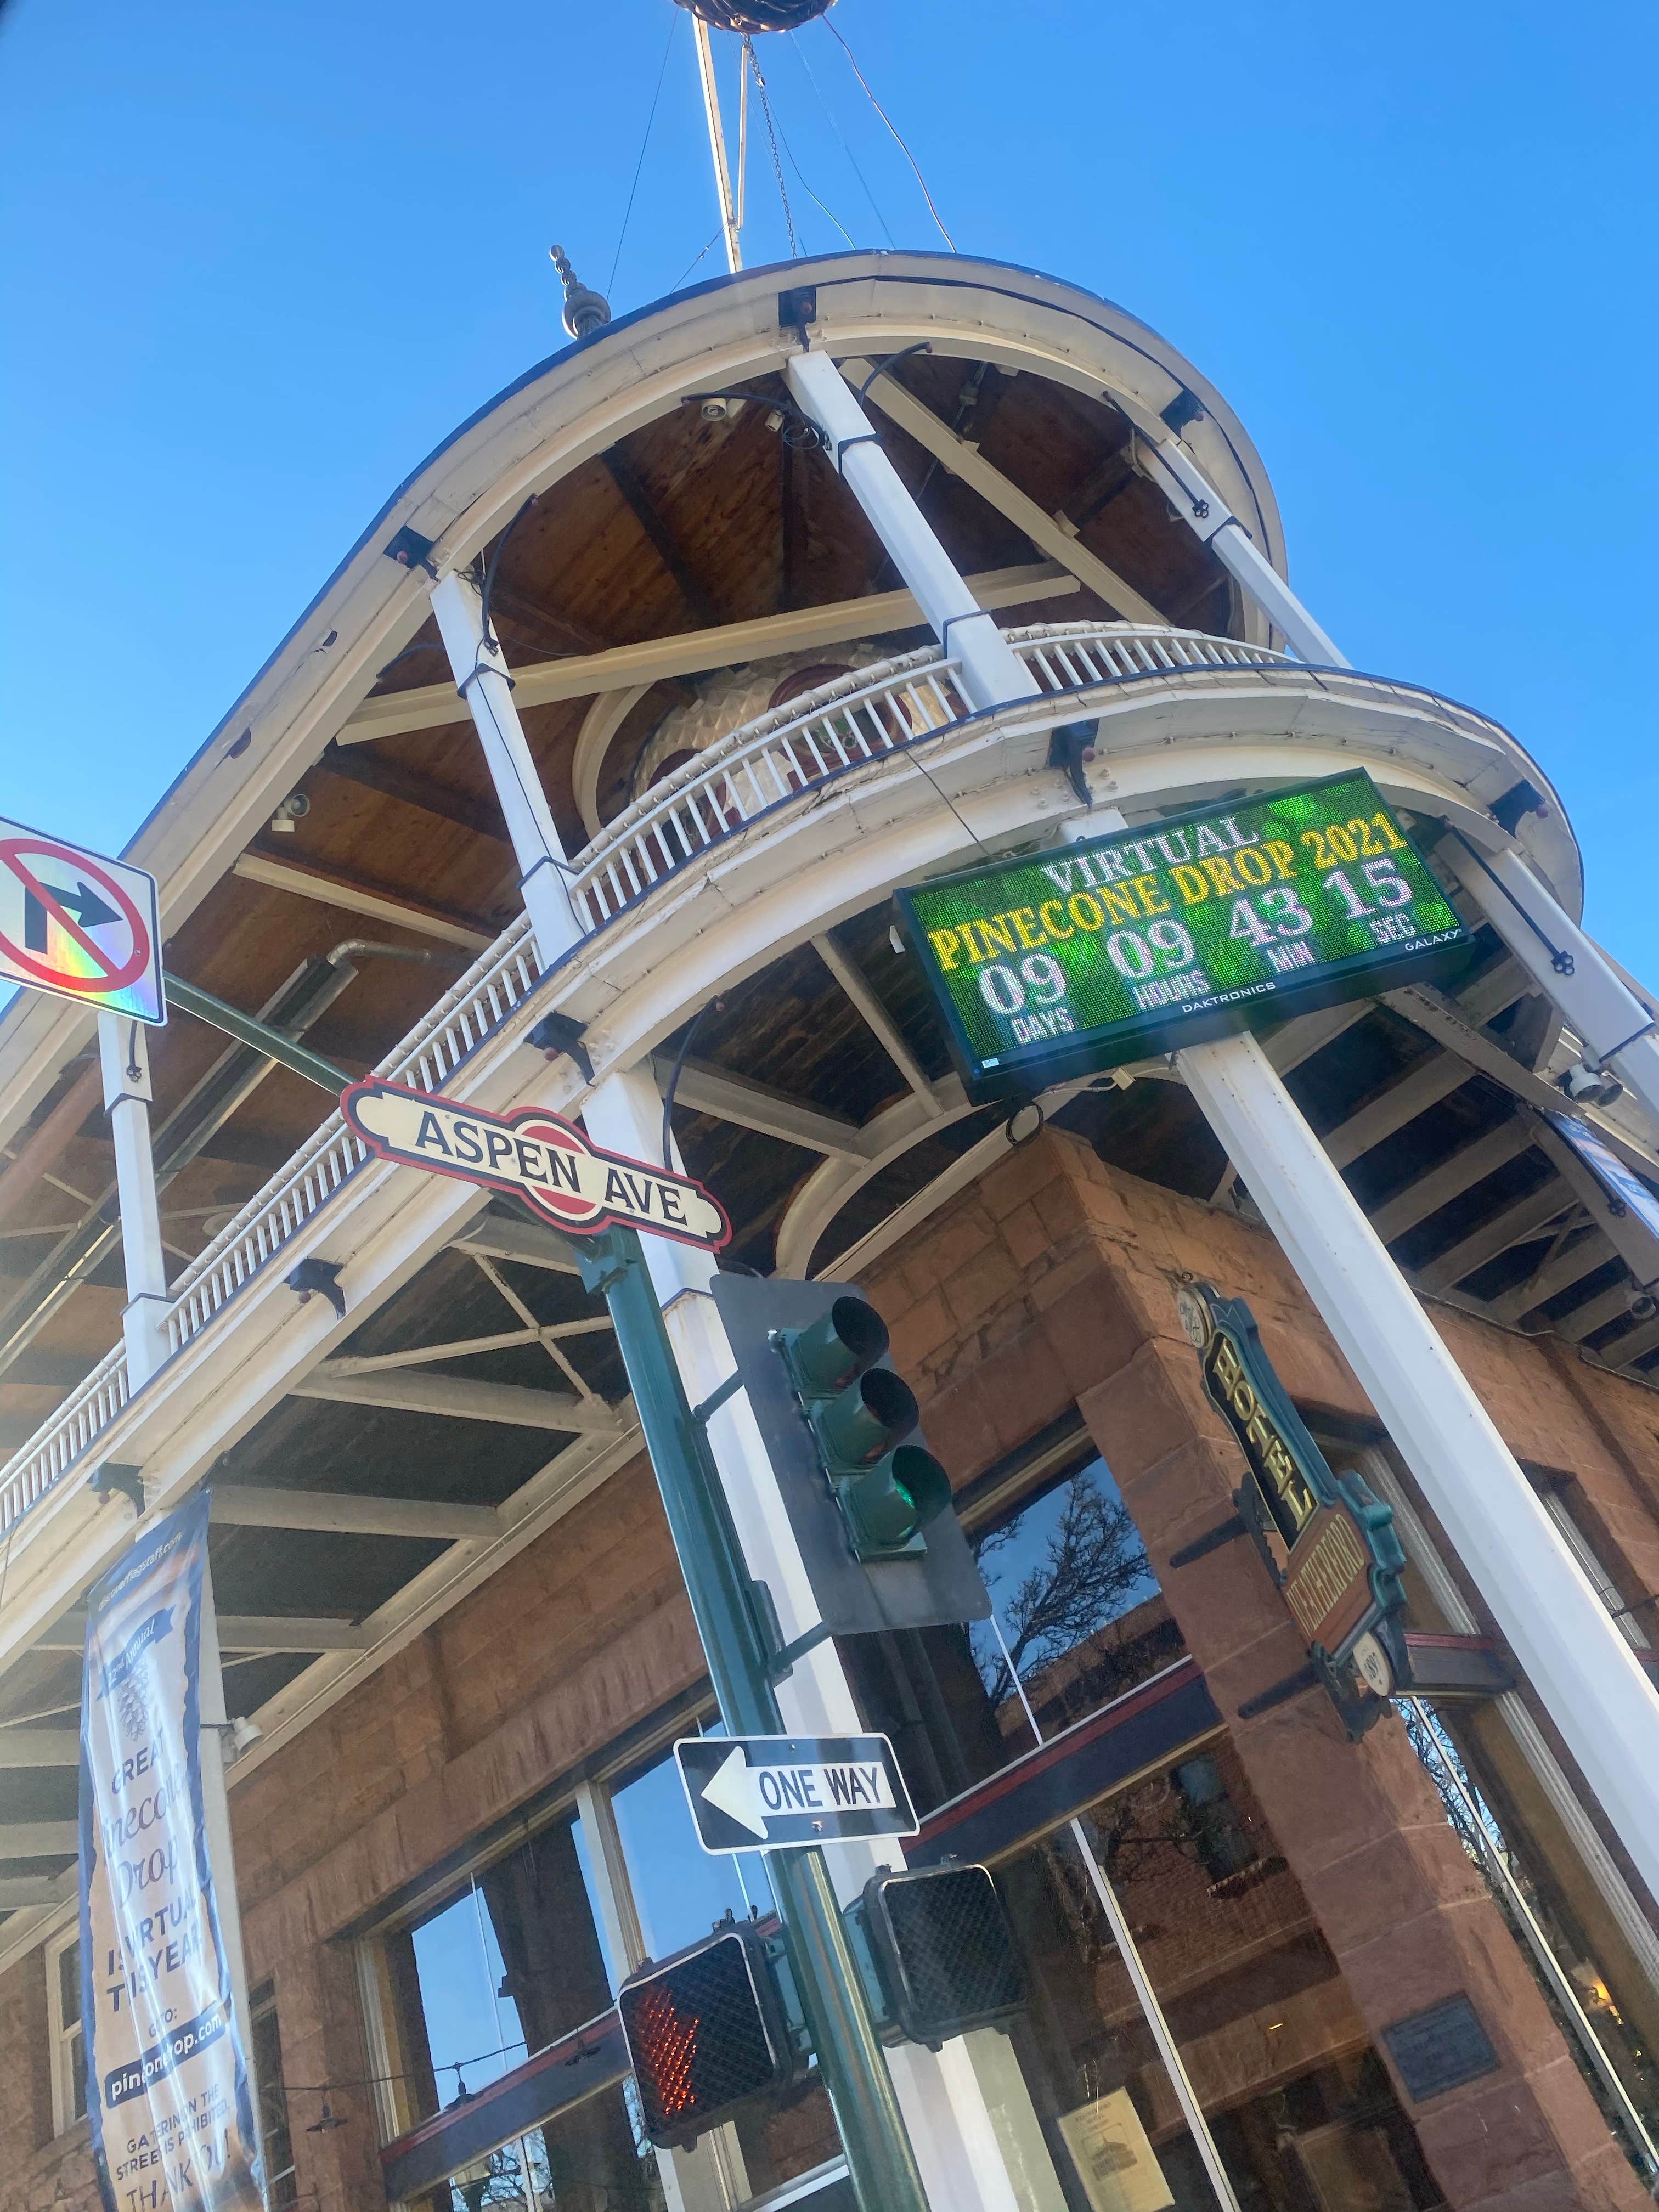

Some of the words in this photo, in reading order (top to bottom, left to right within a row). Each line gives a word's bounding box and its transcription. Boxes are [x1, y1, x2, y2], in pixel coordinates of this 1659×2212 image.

[927, 873, 1171, 970] PINECONE
[1168, 839, 1298, 906] DROP
[1302, 812, 1408, 871] 2021
[1041, 817, 1260, 893] VIRTUAL
[978, 952, 1070, 1017] 09
[1107, 918, 1196, 981] 09
[1228, 885, 1314, 948] 43
[1323, 857, 1414, 921] 15
[1011, 1007, 1077, 1045] DAYS
[1131, 969, 1210, 1012] HOURS
[1267, 940, 1316, 974] MIN
[1369, 913, 1416, 946] SEC
[1182, 981, 1276, 1013] DAKTRONICS
[415, 1110, 582, 1193] ASPEN
[604, 1168, 689, 1227] AVE
[1212, 1336, 1312, 1531] HOTEL
[1286, 1514, 1365, 1638] WEATHERFORD
[759, 1770, 823, 1810] ONE
[824, 1767, 881, 1805] WAY
